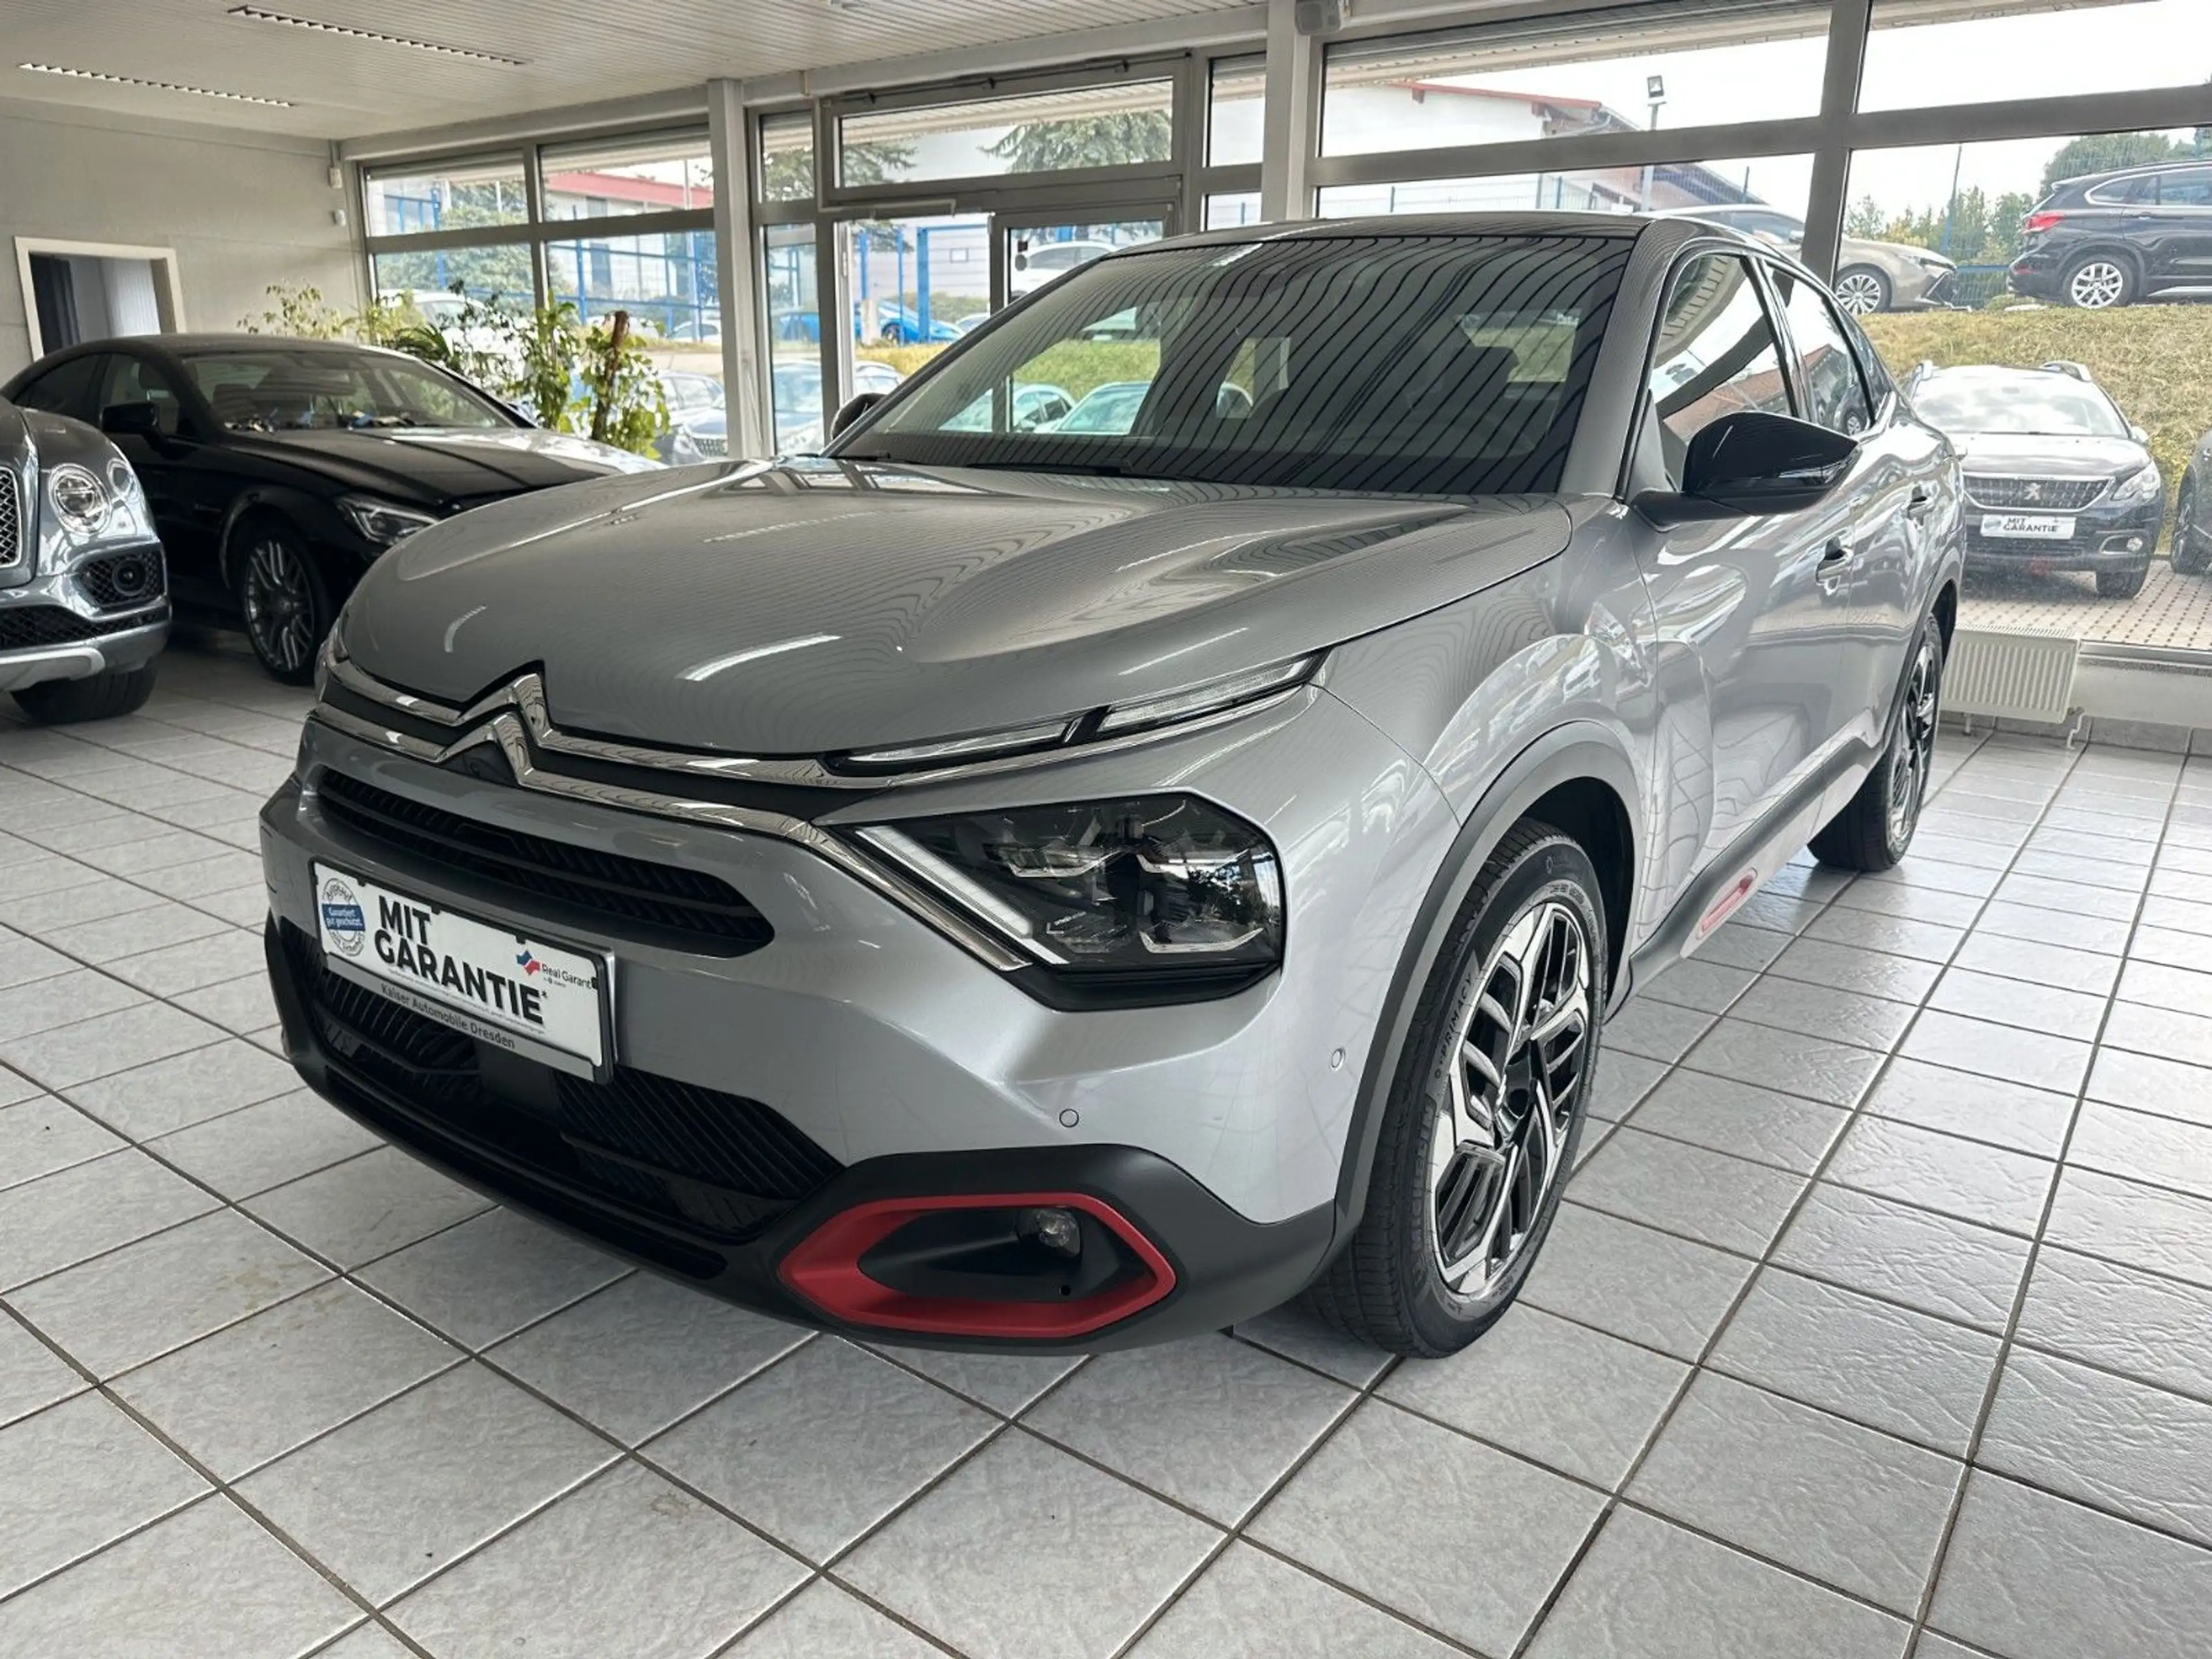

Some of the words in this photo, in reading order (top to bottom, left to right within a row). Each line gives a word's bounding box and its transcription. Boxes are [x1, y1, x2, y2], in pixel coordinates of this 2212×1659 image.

[379, 895, 431, 945] MIT
[542, 963, 561, 978] Real
[562, 971, 591, 989] Garant
[381, 982, 410, 1005] Kaiser
[412, 998, 468, 1031] Automobile
[470, 1022, 516, 1049] Dresden
